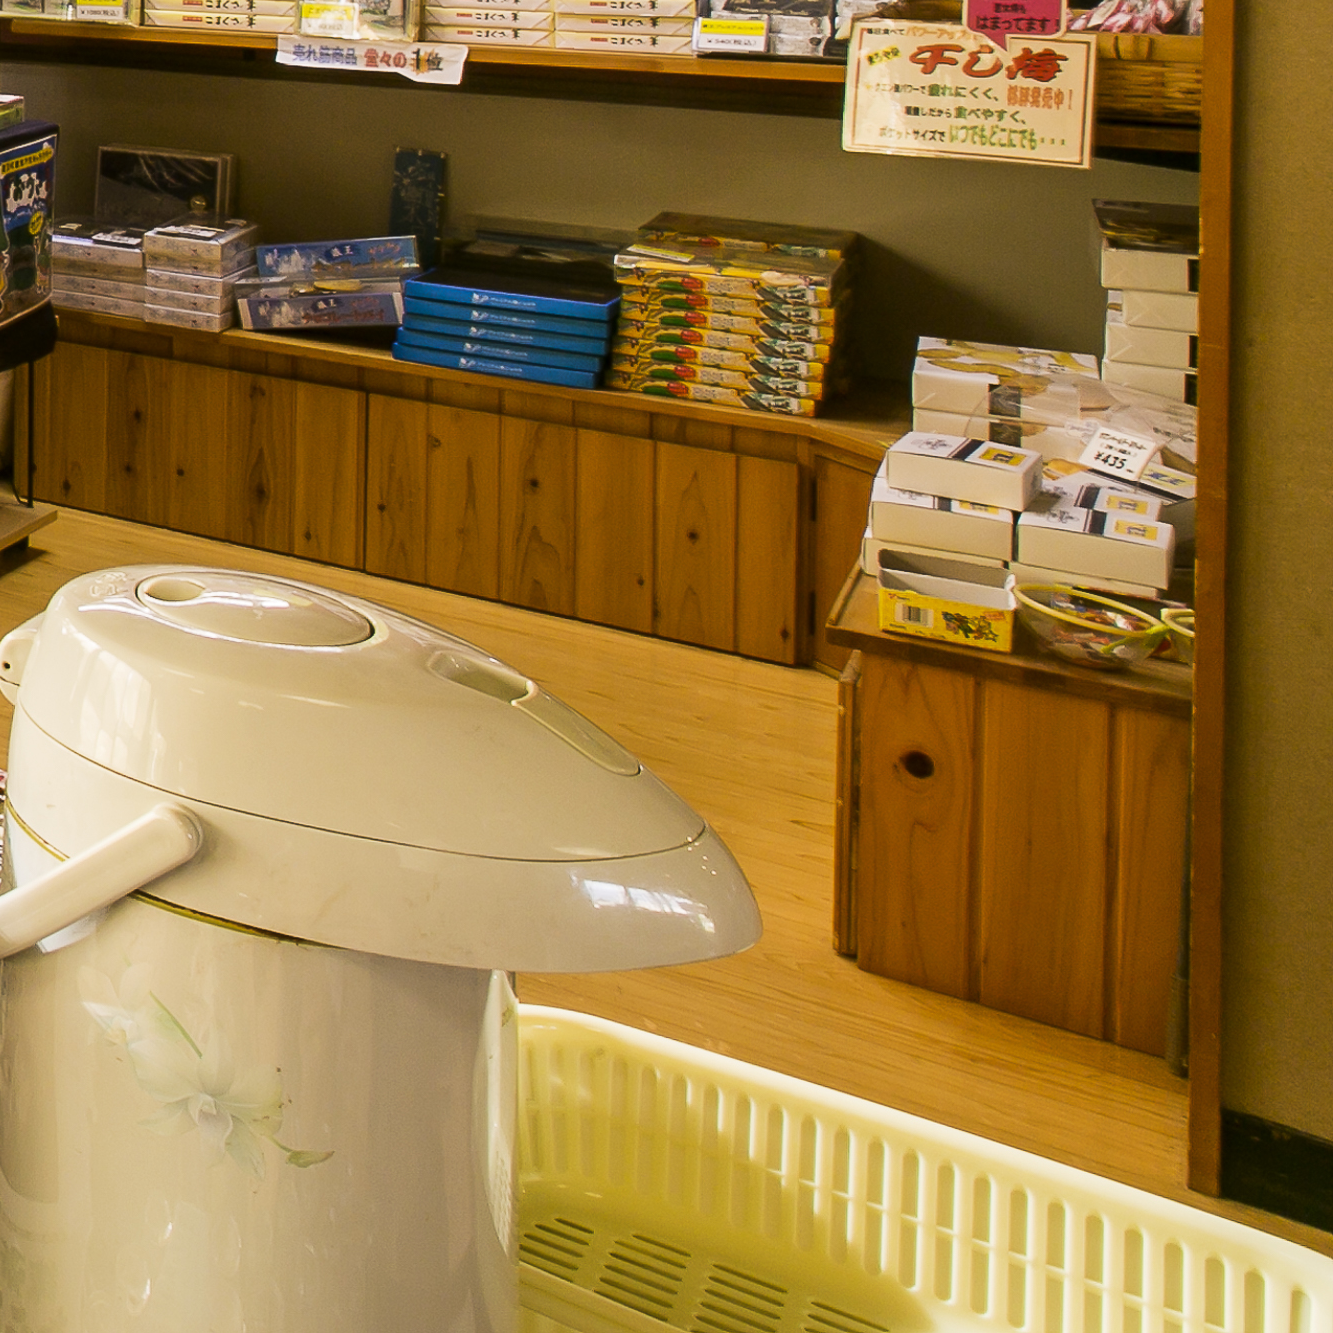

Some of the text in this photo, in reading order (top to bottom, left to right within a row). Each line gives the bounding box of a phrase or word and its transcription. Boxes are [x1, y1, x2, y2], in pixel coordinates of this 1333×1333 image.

[908, 43, 1070, 83] 干し梅
[1093, 452, 1127, 469] ¥435
